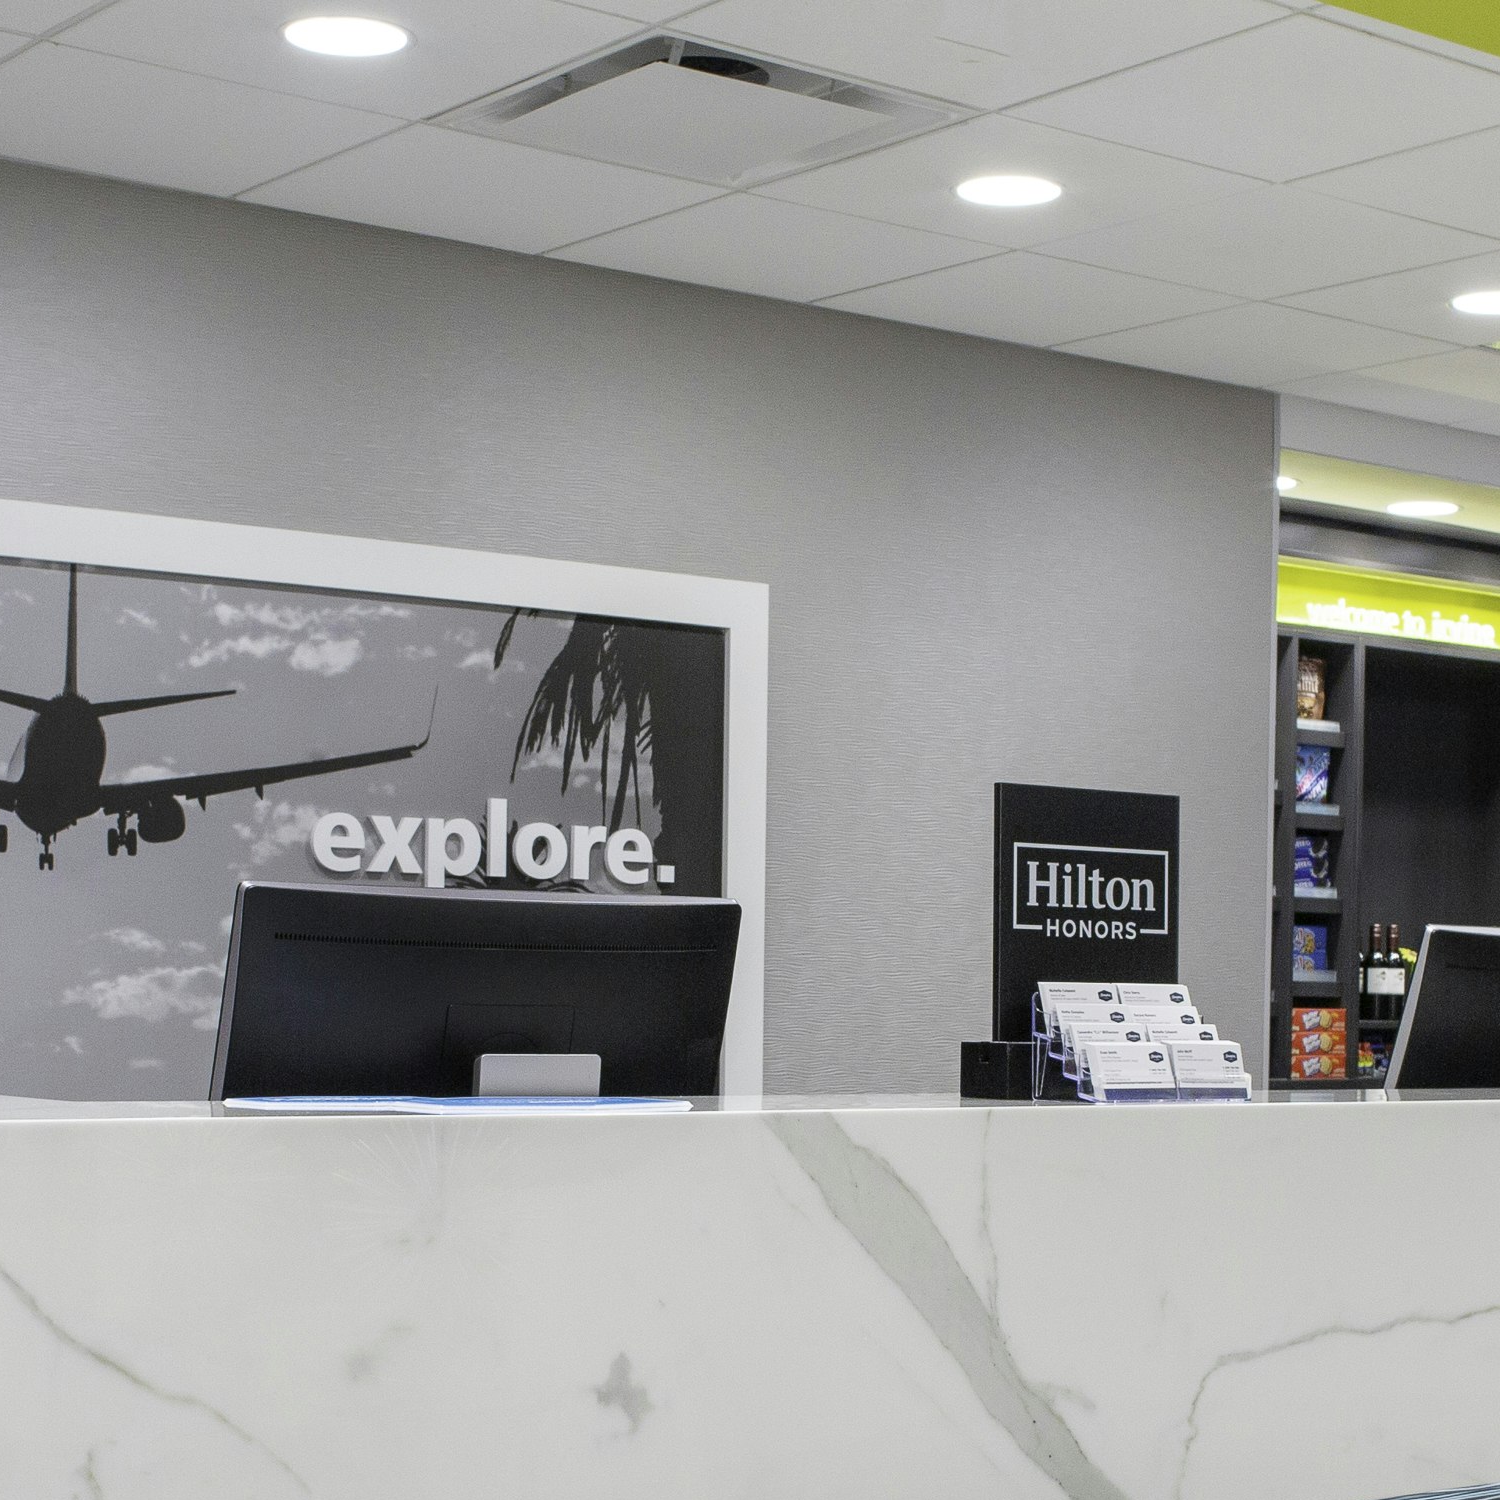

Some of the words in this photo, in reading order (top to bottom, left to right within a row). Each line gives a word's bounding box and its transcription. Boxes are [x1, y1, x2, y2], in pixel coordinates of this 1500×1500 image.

[1305, 597, 1400, 633] welcome
[1402, 610, 1427, 637] to
[311, 797, 676, 889] explore.
[1026, 860, 1157, 912] Hilton
[1046, 918, 1137, 940] HONORS
